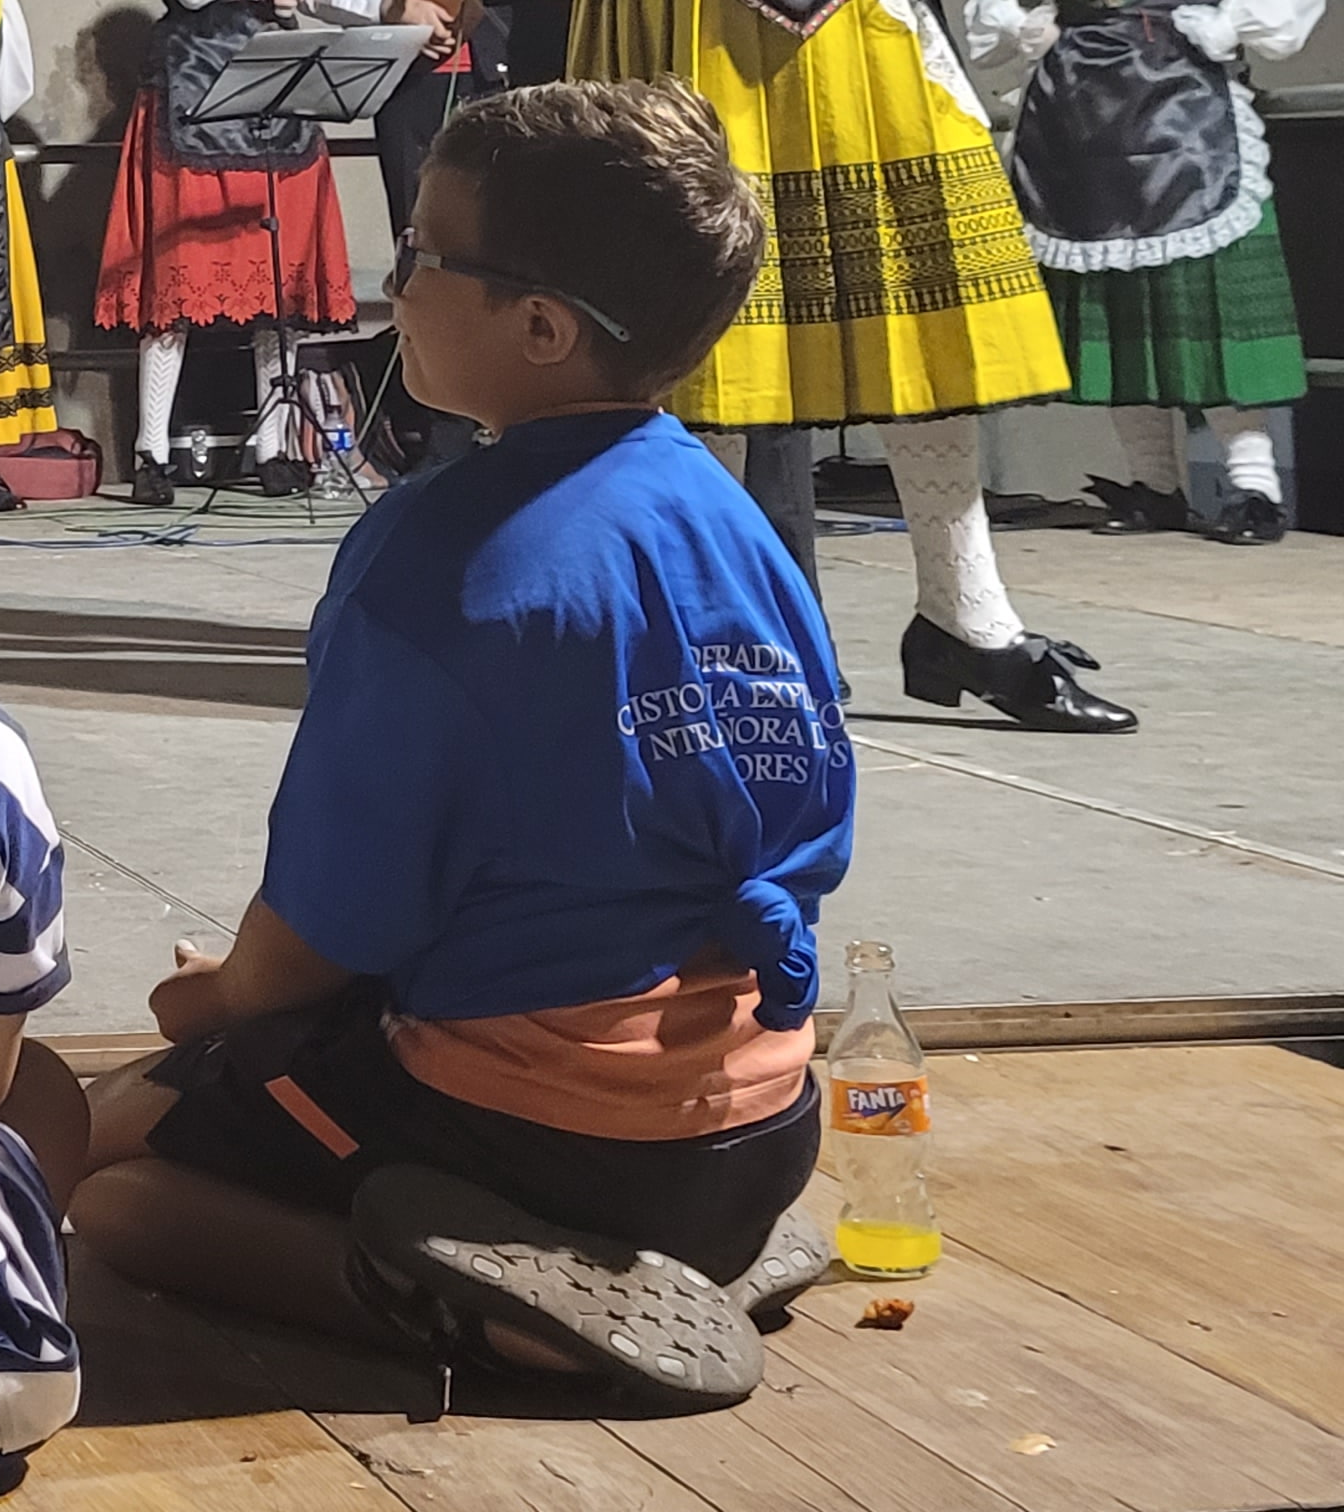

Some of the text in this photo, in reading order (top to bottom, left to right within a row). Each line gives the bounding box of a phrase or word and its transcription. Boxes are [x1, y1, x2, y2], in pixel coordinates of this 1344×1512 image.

[716, 712, 805, 746] ÑORA
[734, 754, 809, 784] ORES
[847, 1088, 906, 1110] FANTA
